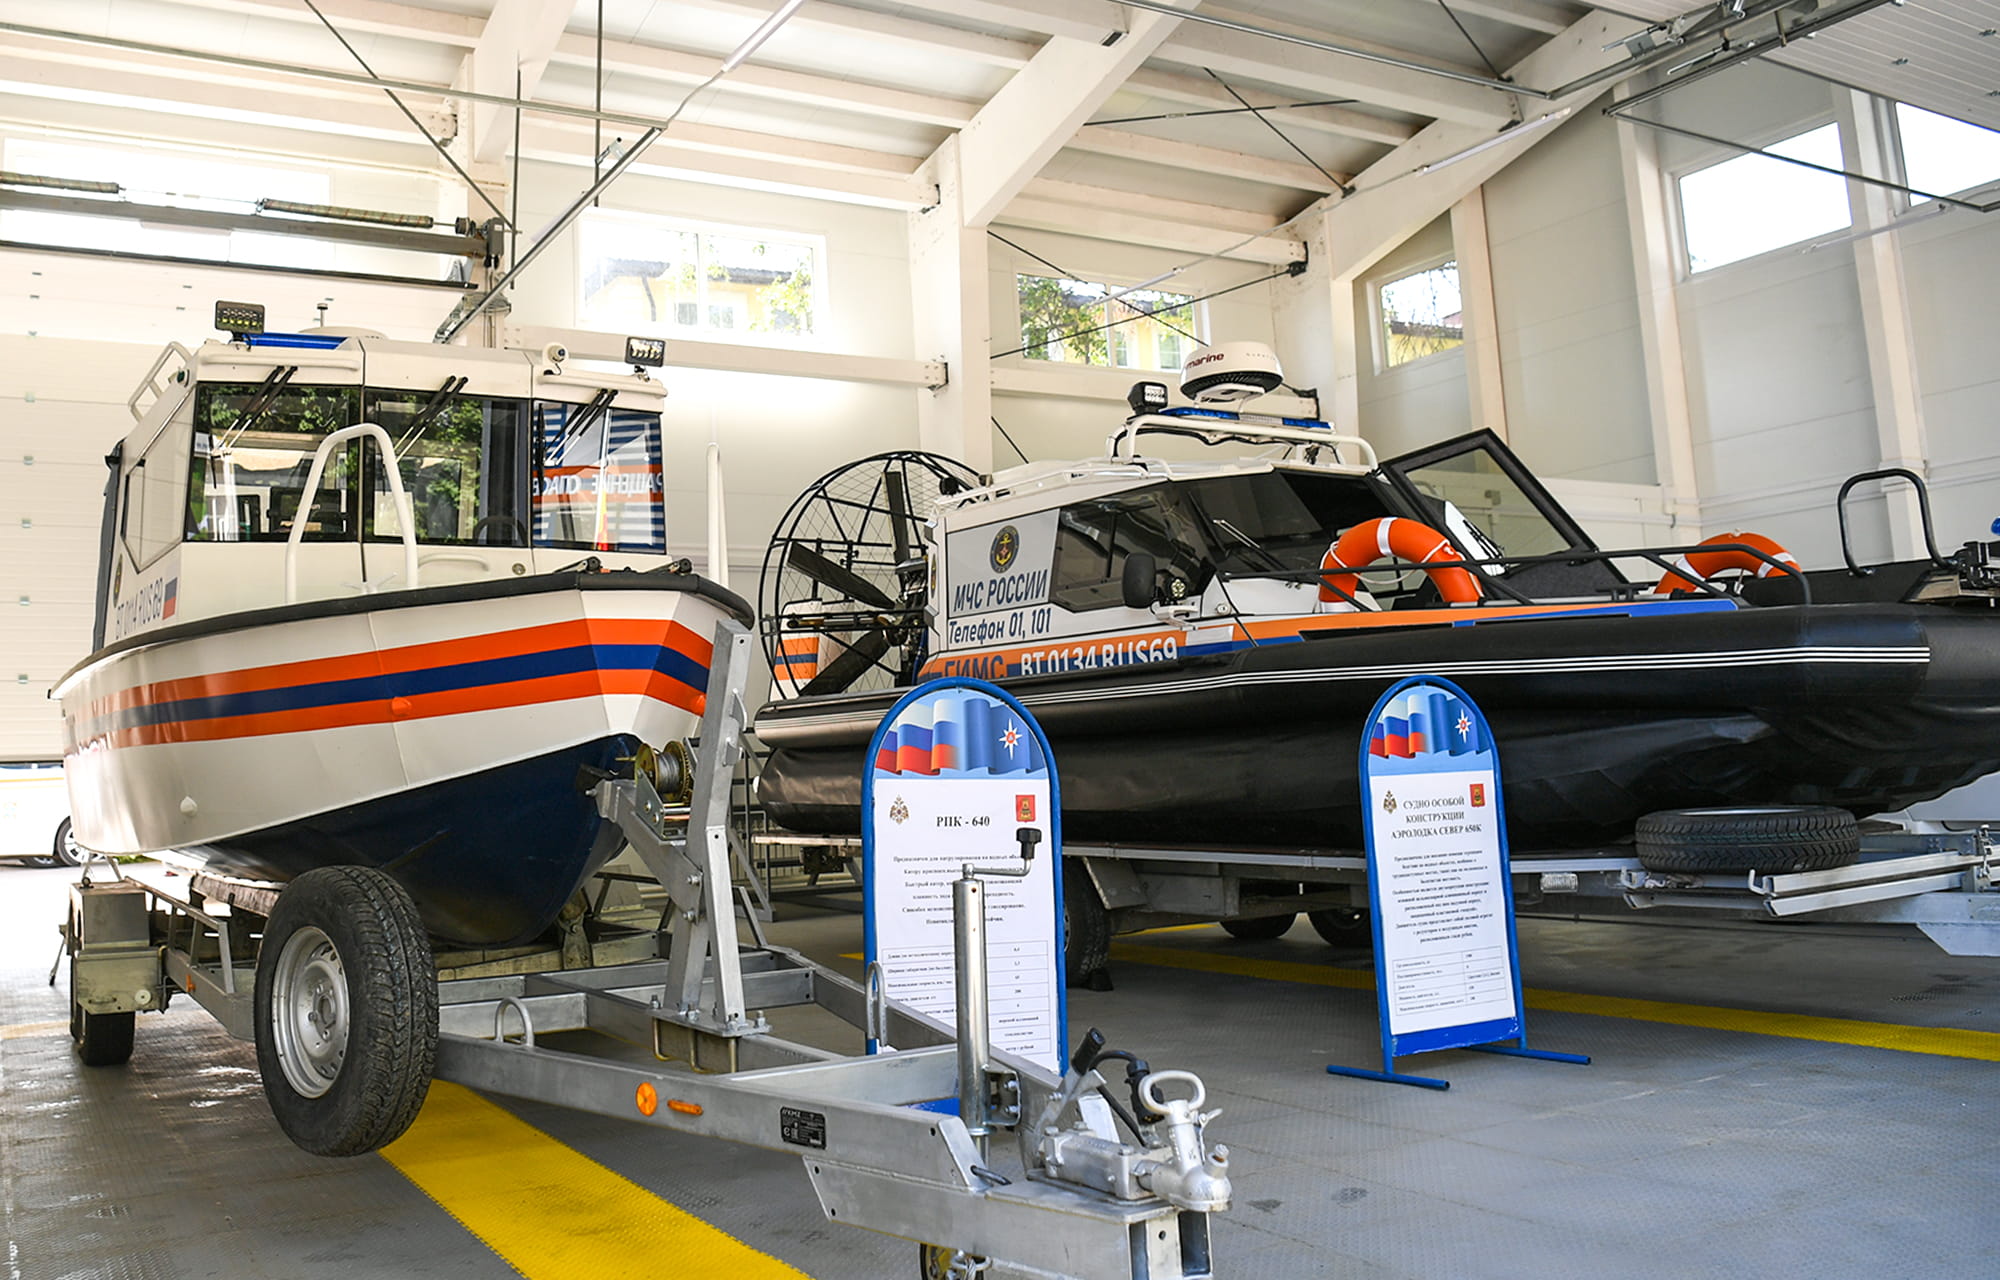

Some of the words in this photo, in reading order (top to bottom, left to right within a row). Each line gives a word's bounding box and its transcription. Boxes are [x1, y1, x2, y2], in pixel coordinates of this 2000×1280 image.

[954, 581, 985, 612] МЧС
[986, 569, 1048, 607] РОССИИ
[949, 618, 1006, 645] Телефон
[1009, 612, 1026, 640] 01,
[1031, 608, 1052, 635] 101
[944, 655, 1007, 680] ГИМС
[1403, 799, 1430, 809] СУДНО
[1432, 796, 1464, 808] ОСОБОЙ
[936, 815, 963, 827] РПК
[971, 815, 990, 827] 640
[1406, 811, 1464, 824] КОНСТРУКЦИИ
[1392, 828, 1438, 839] АЭРОЛОДКА
[1439, 825, 1463, 836] СЕВЕР
